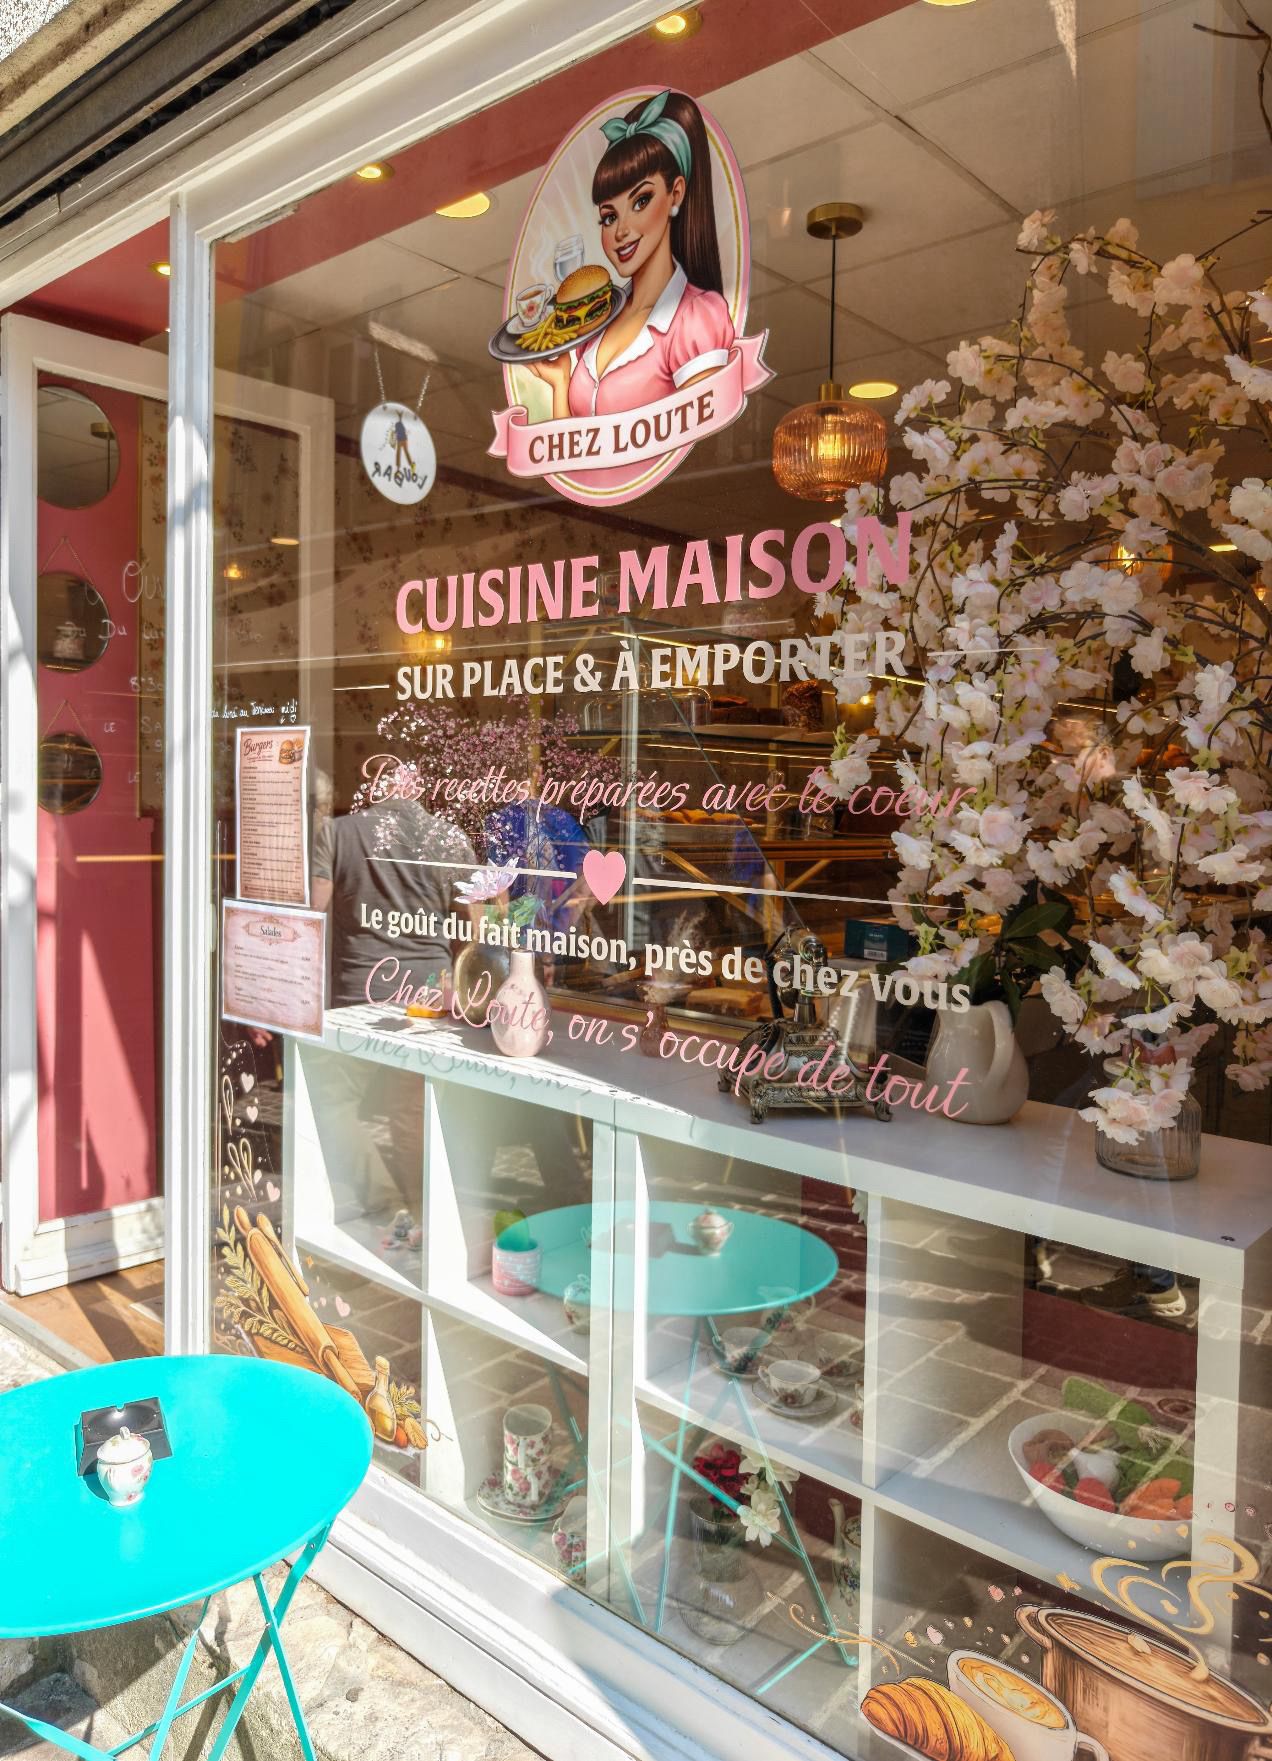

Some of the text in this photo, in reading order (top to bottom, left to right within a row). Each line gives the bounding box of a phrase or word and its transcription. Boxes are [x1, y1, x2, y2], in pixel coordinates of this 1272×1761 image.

[529, 390, 715, 464] CHEZ LOUTE
[396, 511, 913, 635] CUISINE MAISON
[397, 630, 909, 701] SUR PLACE & À EMPORTER
[243, 738, 273, 757] Burgers
[362, 754, 977, 825] Des recettes préparées avec le coeur
[260, 925, 282, 938] Salades
[361, 903, 971, 1014] Le goût du fait maison, près de chez vous
[364, 956, 443, 1012] Chez
[451, 970, 554, 1046] Loute,
[568, 1013, 614, 1046] on
[796, 1045, 855, 1093] de
[864, 1054, 975, 1119] tout
